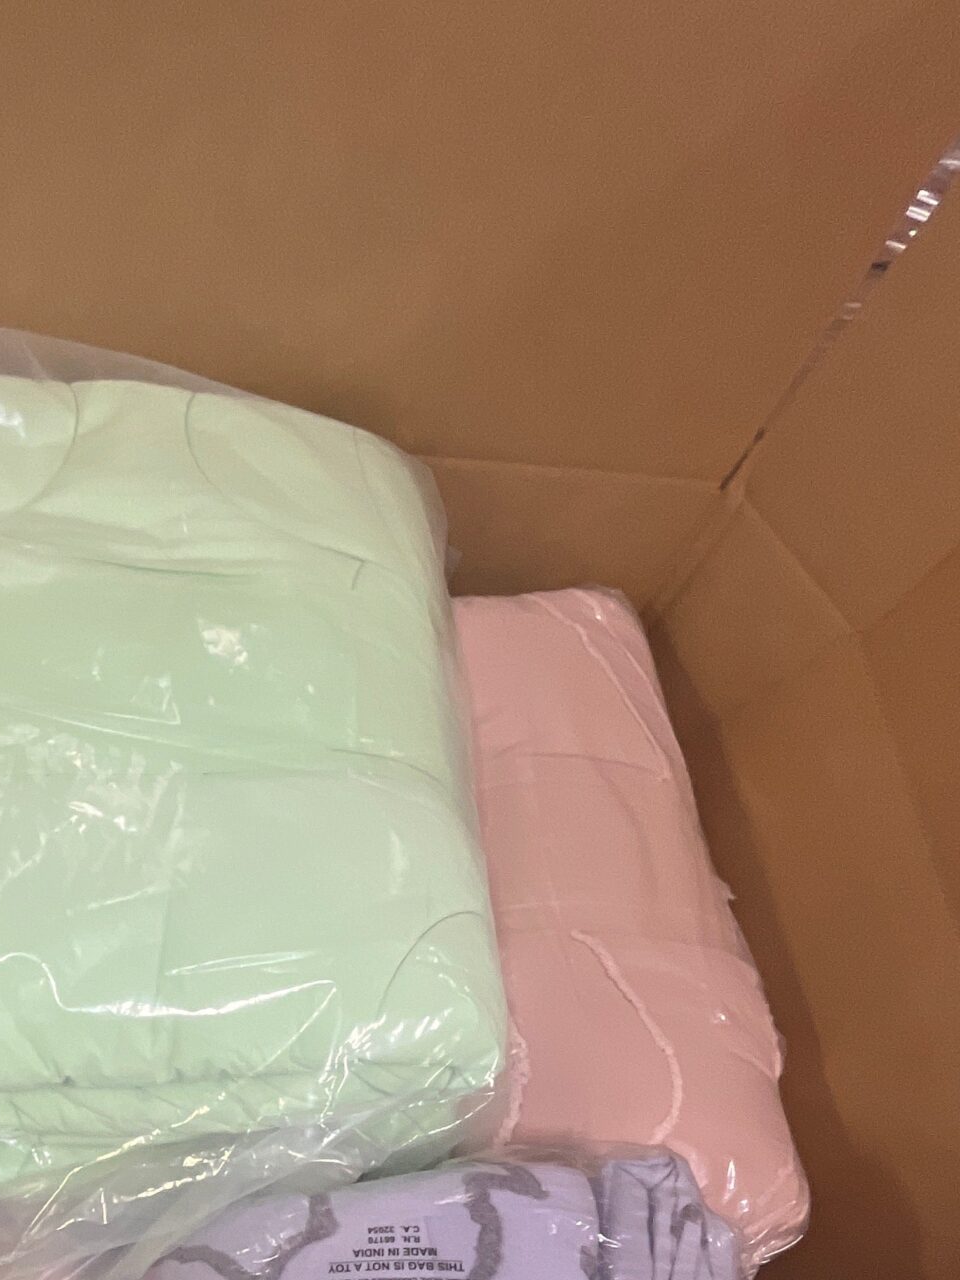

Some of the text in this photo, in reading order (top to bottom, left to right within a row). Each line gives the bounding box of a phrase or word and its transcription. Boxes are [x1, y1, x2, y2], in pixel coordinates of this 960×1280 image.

[352, 1248, 438, 1258] MADE IN INDIA
[328, 1262, 465, 1273] THIS BAG IS NOT A TOY
